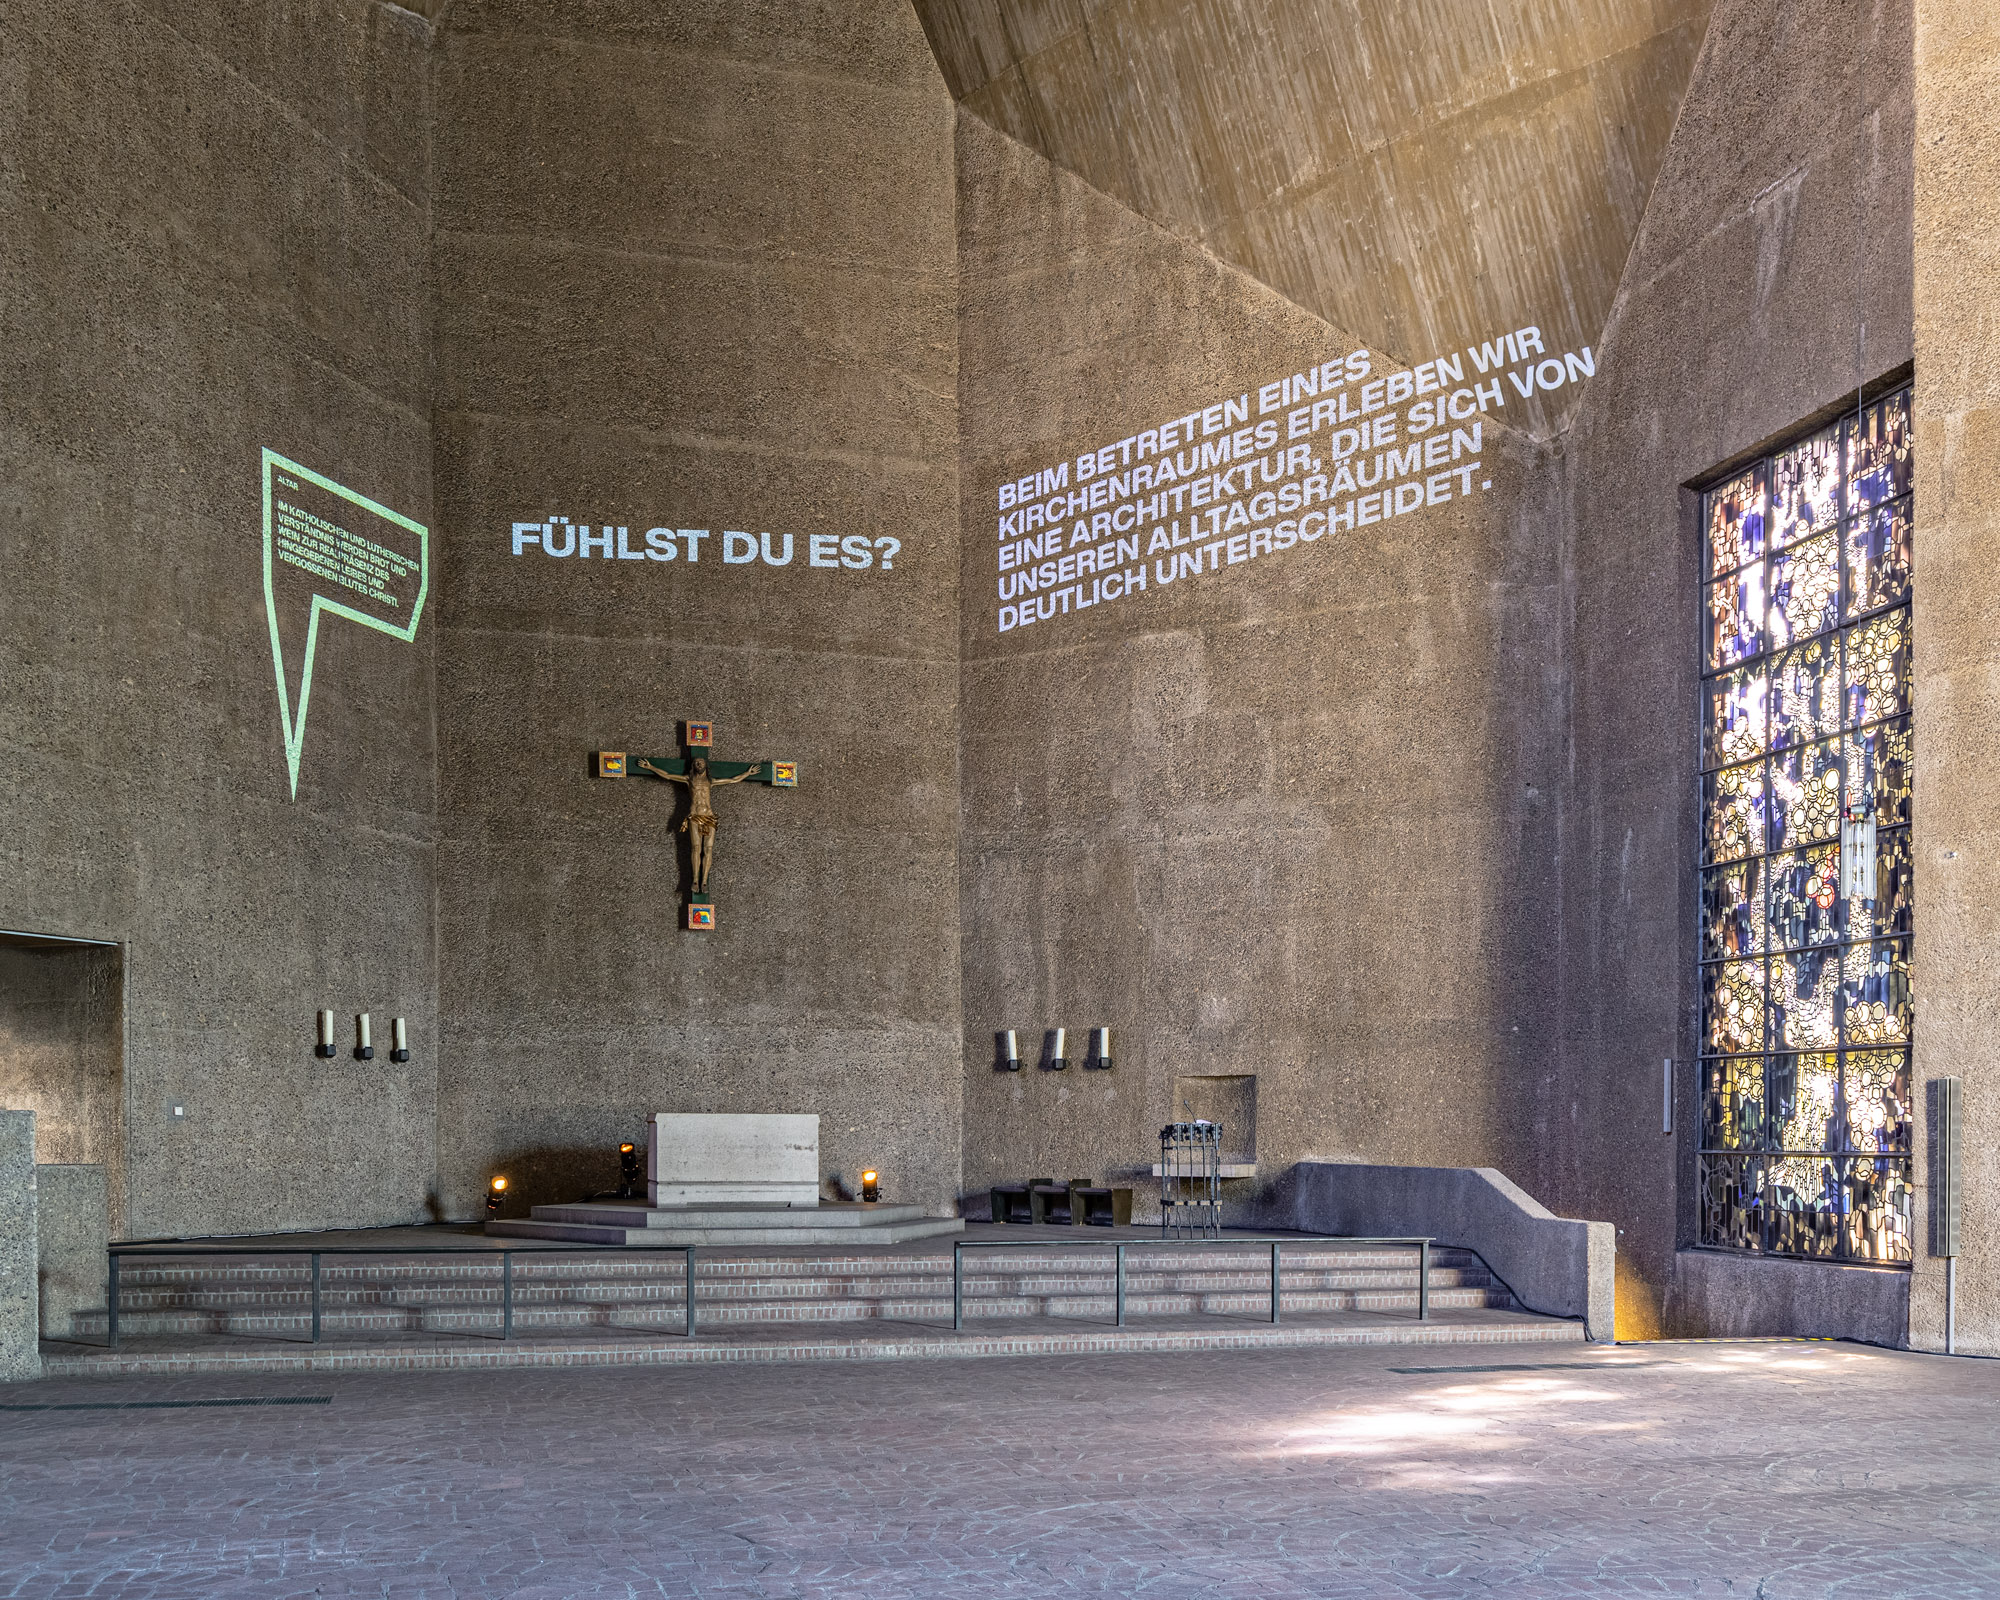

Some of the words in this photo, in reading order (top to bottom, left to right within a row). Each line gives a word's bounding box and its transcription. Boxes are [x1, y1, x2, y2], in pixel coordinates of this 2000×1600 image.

[999, 466, 1068, 510] BEIM
[1075, 394, 1249, 480] BETRETEN
[1259, 349, 1370, 417] EINES
[999, 423, 1279, 540] KIRCHENRAUMES
[1288, 352, 1461, 438] ERLEBEN
[1467, 326, 1544, 375] WIR
[999, 529, 1062, 571] EINE
[1069, 444, 1322, 547] ARCHITEKTUR,
[1331, 417, 1397, 461] DIE
[1406, 382, 1505, 434] SICH
[1512, 346, 1596, 400] VON
[278, 476, 299, 491] ALTAR
[999, 536, 1140, 600] UNSEREN
[1146, 422, 1483, 557] ALLTAGSRÄUMEN
[278, 501, 288, 512] IM
[289, 503, 349, 540] KATHOLISCHEN
[350, 532, 366, 547] UND
[367, 539, 419, 571] LUTHERISCHEN
[278, 513, 334, 545] VERSTÄNDNIS
[370, 551, 390, 568] BROT
[390, 562, 406, 577] UND
[278, 525, 300, 543] WEIN
[302, 534, 318, 551] ZUR
[375, 566, 390, 580] DES
[278, 537, 340, 571] HINGEGEBENEN
[342, 562, 367, 583] LEIBES
[368, 575, 384, 589] UND
[512, 516, 709, 563] FÜHLST
[723, 531, 794, 566] DU
[809, 534, 901, 570] ES?
[999, 568, 1147, 632] DEUTLICH
[1156, 462, 1493, 585] UNTERSCHEIDET.
[278, 549, 338, 583] VERGOSSENEN
[339, 575, 367, 594] BLUTES
